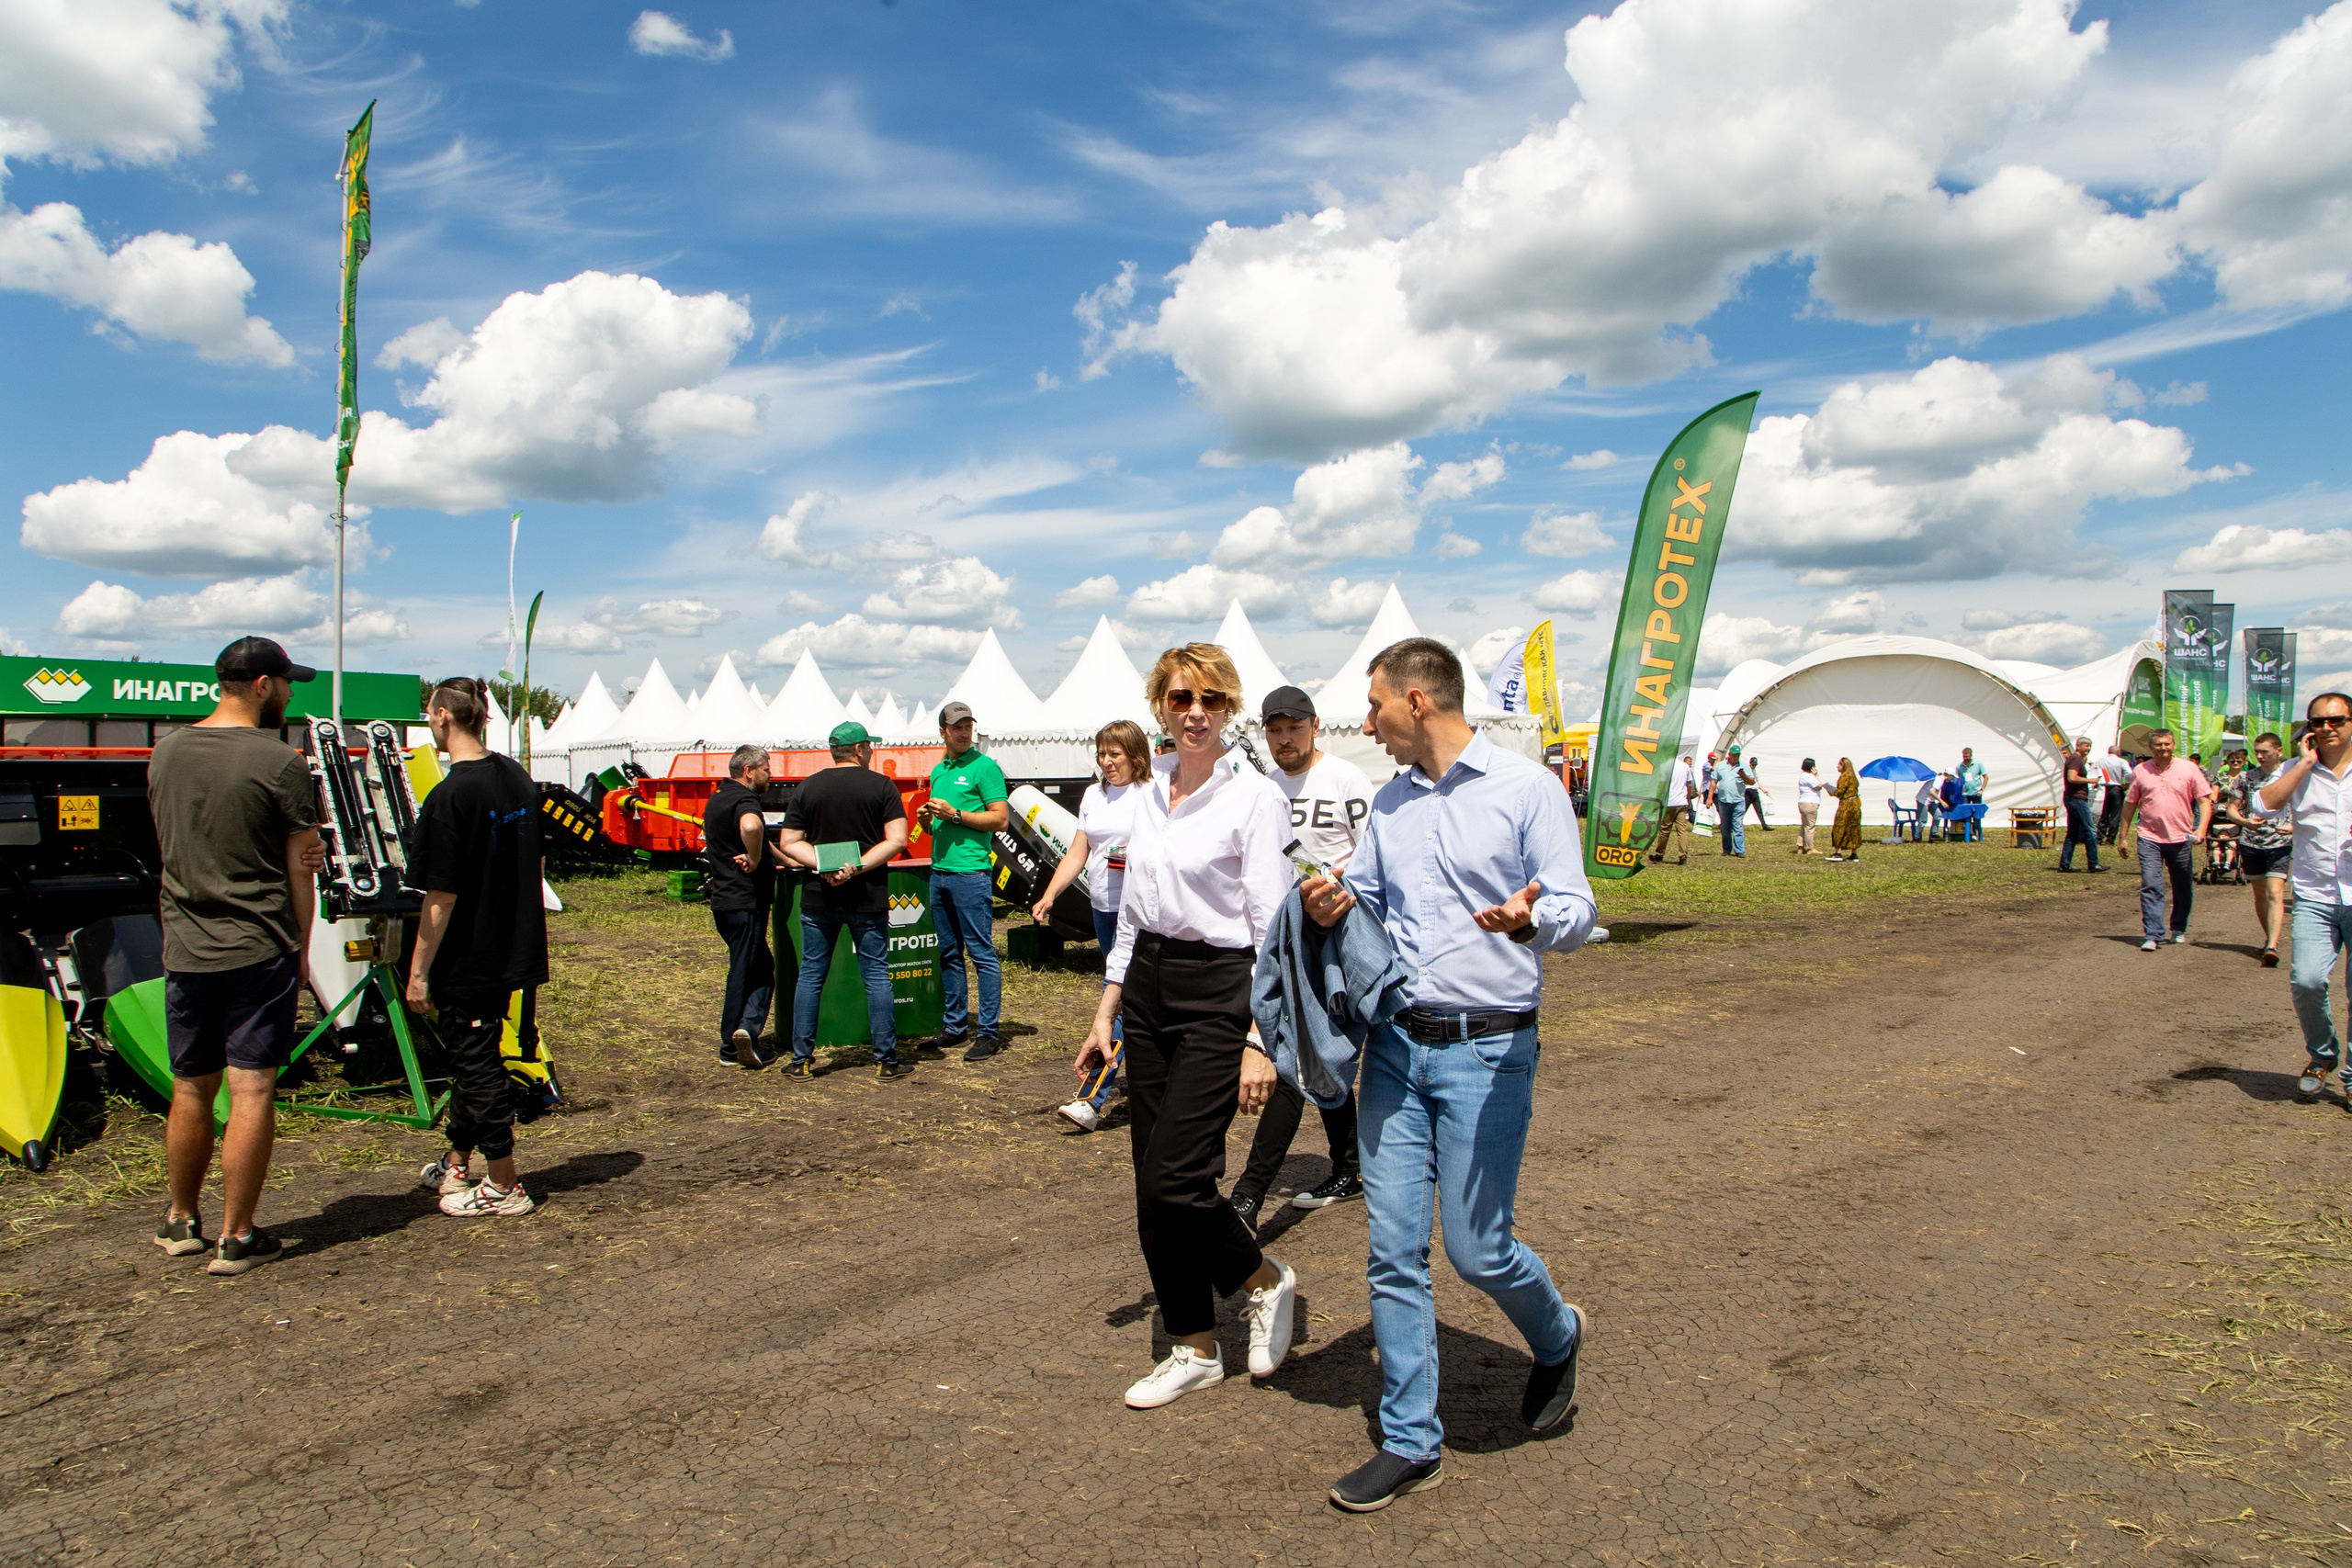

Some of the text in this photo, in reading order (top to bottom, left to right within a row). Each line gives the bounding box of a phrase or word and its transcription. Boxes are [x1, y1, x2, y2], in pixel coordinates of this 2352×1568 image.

[1620, 475, 1713, 775] ИНАГРОТЕХ
[2174, 649, 2207, 657] ШАНС
[2192, 681, 2202, 732] профессия
[2180, 730, 2188, 760] ащита
[1017, 852, 1035, 872] 6R
[896, 970, 910, 979] 550
[912, 969, 922, 977] 80
[923, 967, 933, 976] 22
